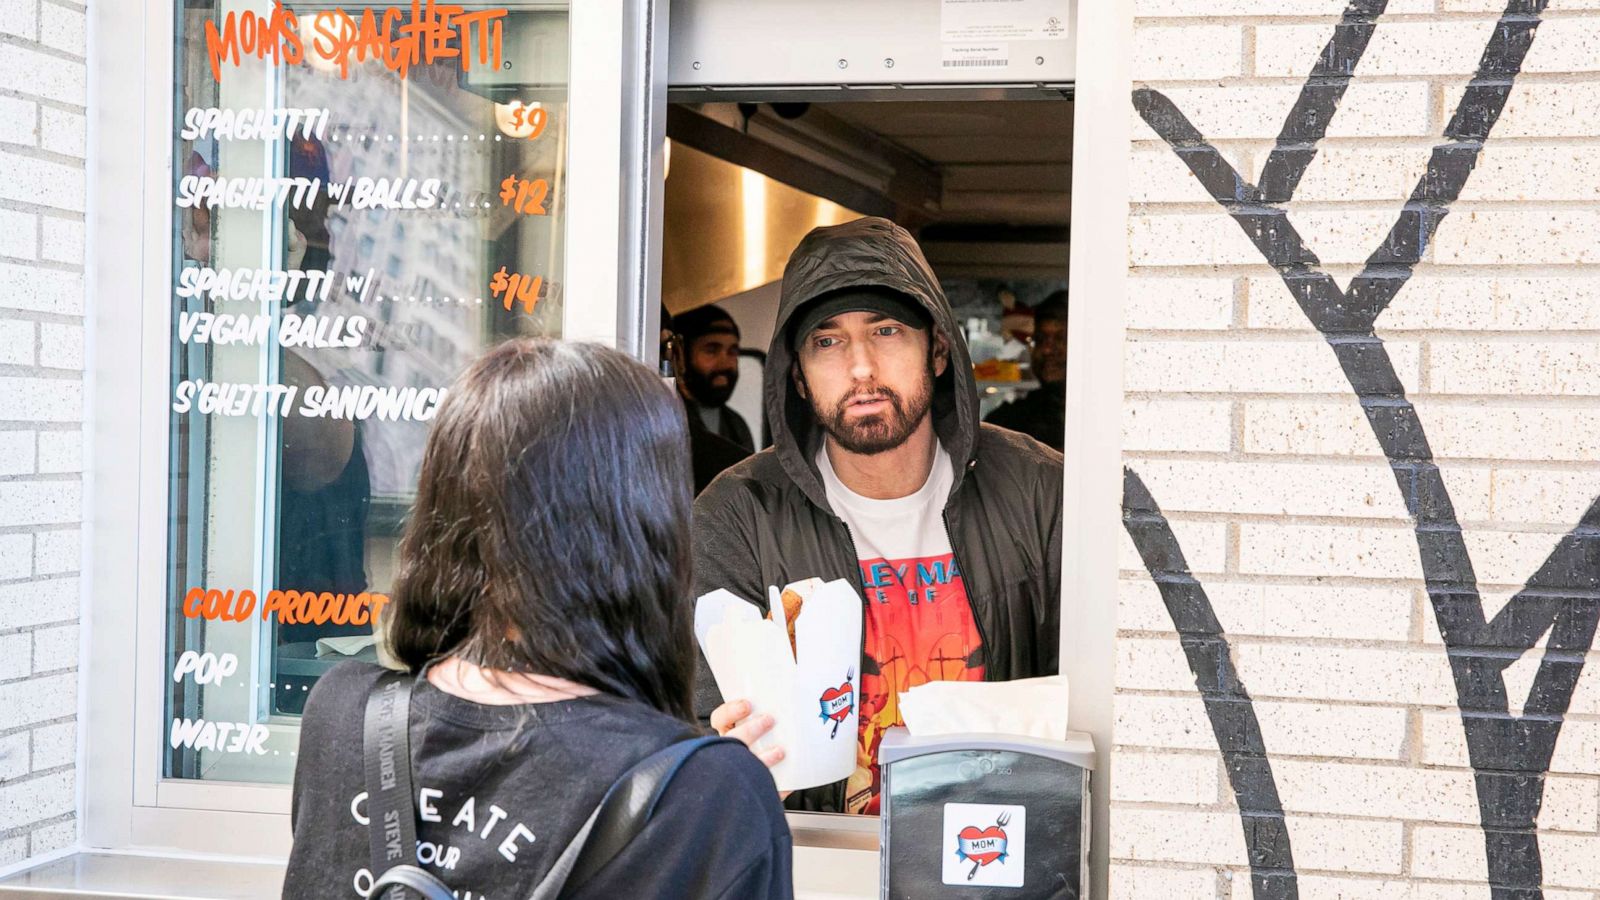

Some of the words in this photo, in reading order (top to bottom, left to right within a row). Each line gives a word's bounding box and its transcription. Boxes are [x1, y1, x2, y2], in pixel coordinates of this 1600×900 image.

[313, 0, 508, 80] SPAGHETTI
[180, 107, 329, 140] SPAGHETTI
[511, 104, 547, 140] $9
[176, 175, 320, 211] SPAGHETTI
[500, 174, 548, 215] $12
[176, 267, 334, 302] SPAGHETTI
[346, 267, 375, 303] w/
[489, 265, 543, 315] $14
[178, 311, 270, 347] VEGAN
[278, 314, 367, 348] BALLS
[182, 587, 256, 622] COLD
[173, 651, 238, 687] POP
[831, 696, 848, 710] MOM
[170, 718, 270, 756] WATER
[379, 724, 397, 791] MADDEN
[350, 787, 536, 863] CEATE
[383, 809, 403, 861] STEVE
[416, 840, 461, 870] OUR
[971, 839, 995, 850] MOM
